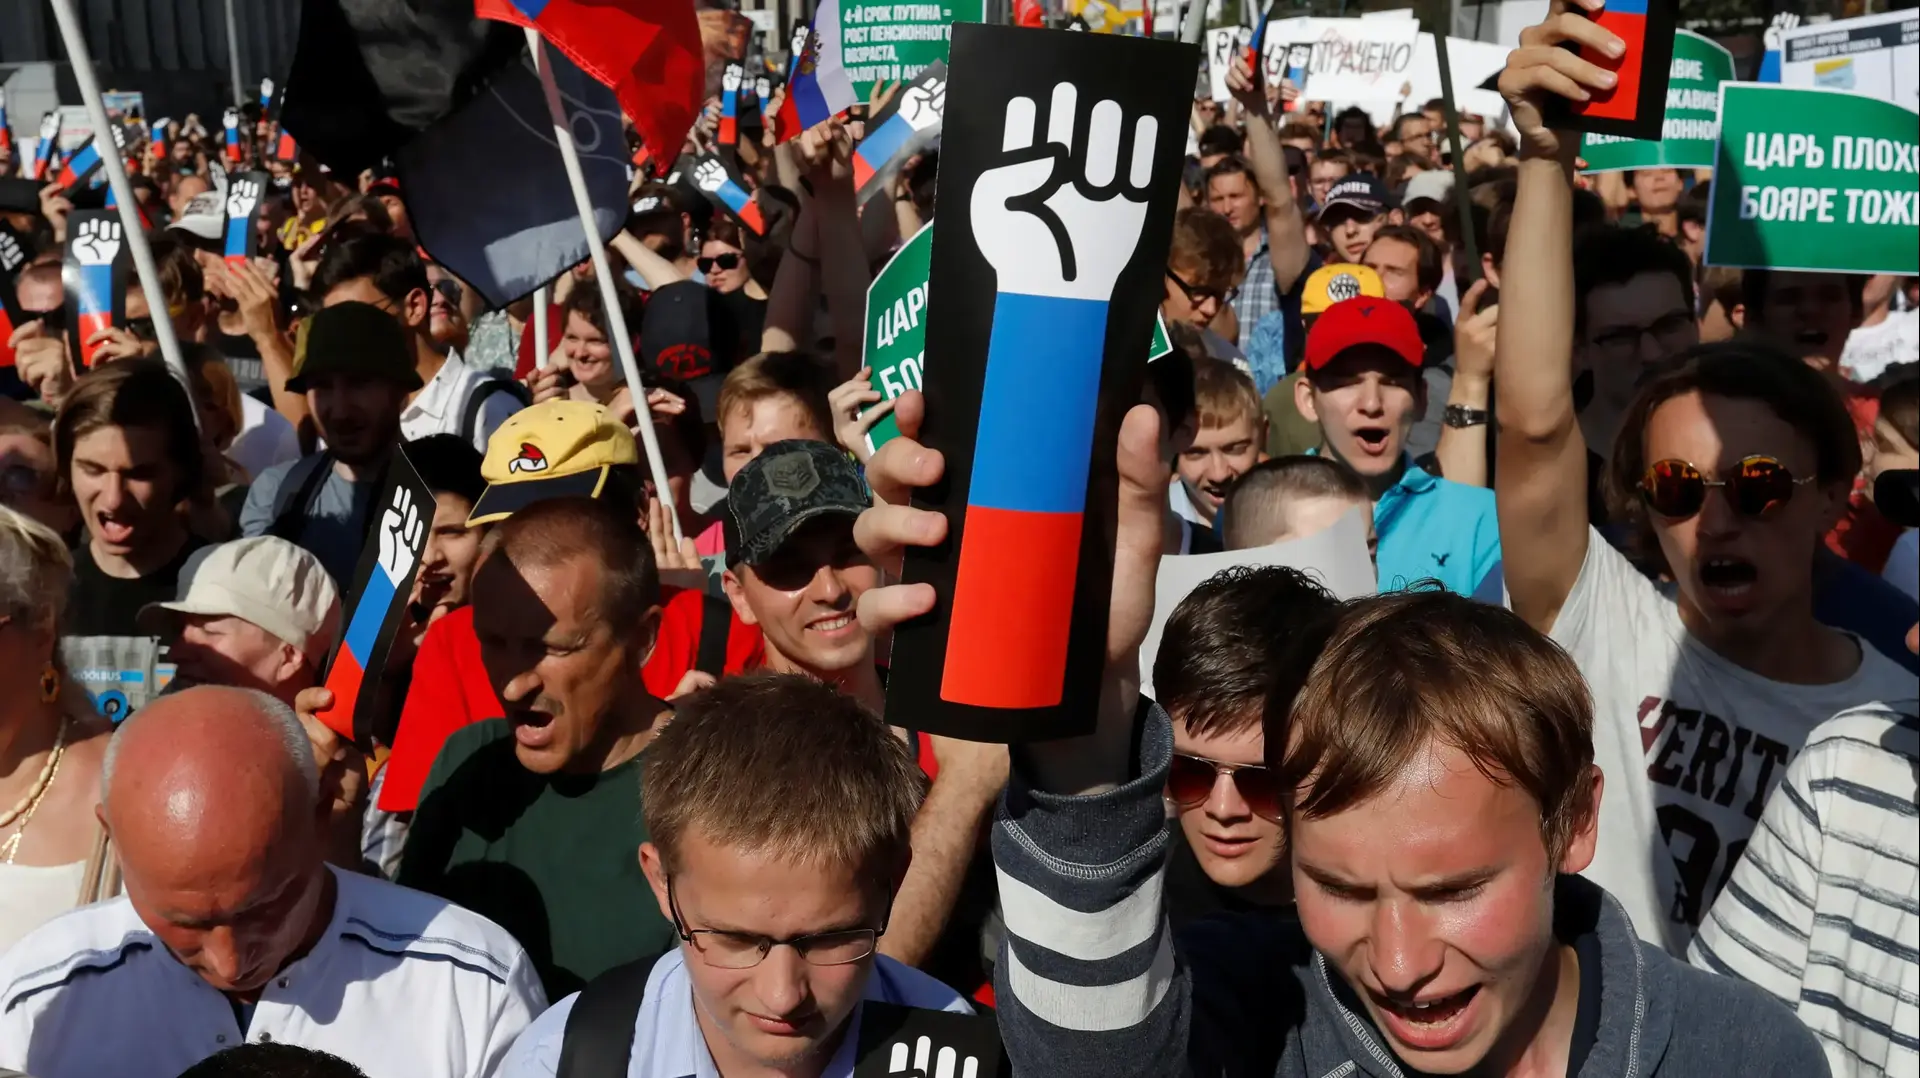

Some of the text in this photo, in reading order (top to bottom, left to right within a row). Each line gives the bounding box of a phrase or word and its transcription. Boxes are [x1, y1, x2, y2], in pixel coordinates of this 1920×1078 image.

[863, 5, 892, 23] СРОК
[893, 4, 941, 21] ПУТИНА
[844, 24, 952, 44] РОСТ ПЕНСИОННОГО
[1744, 132, 1825, 171] ЦАРЬ
[1739, 185, 1838, 223] БОЯРЕ
[1637, 696, 1799, 822] VERIT
